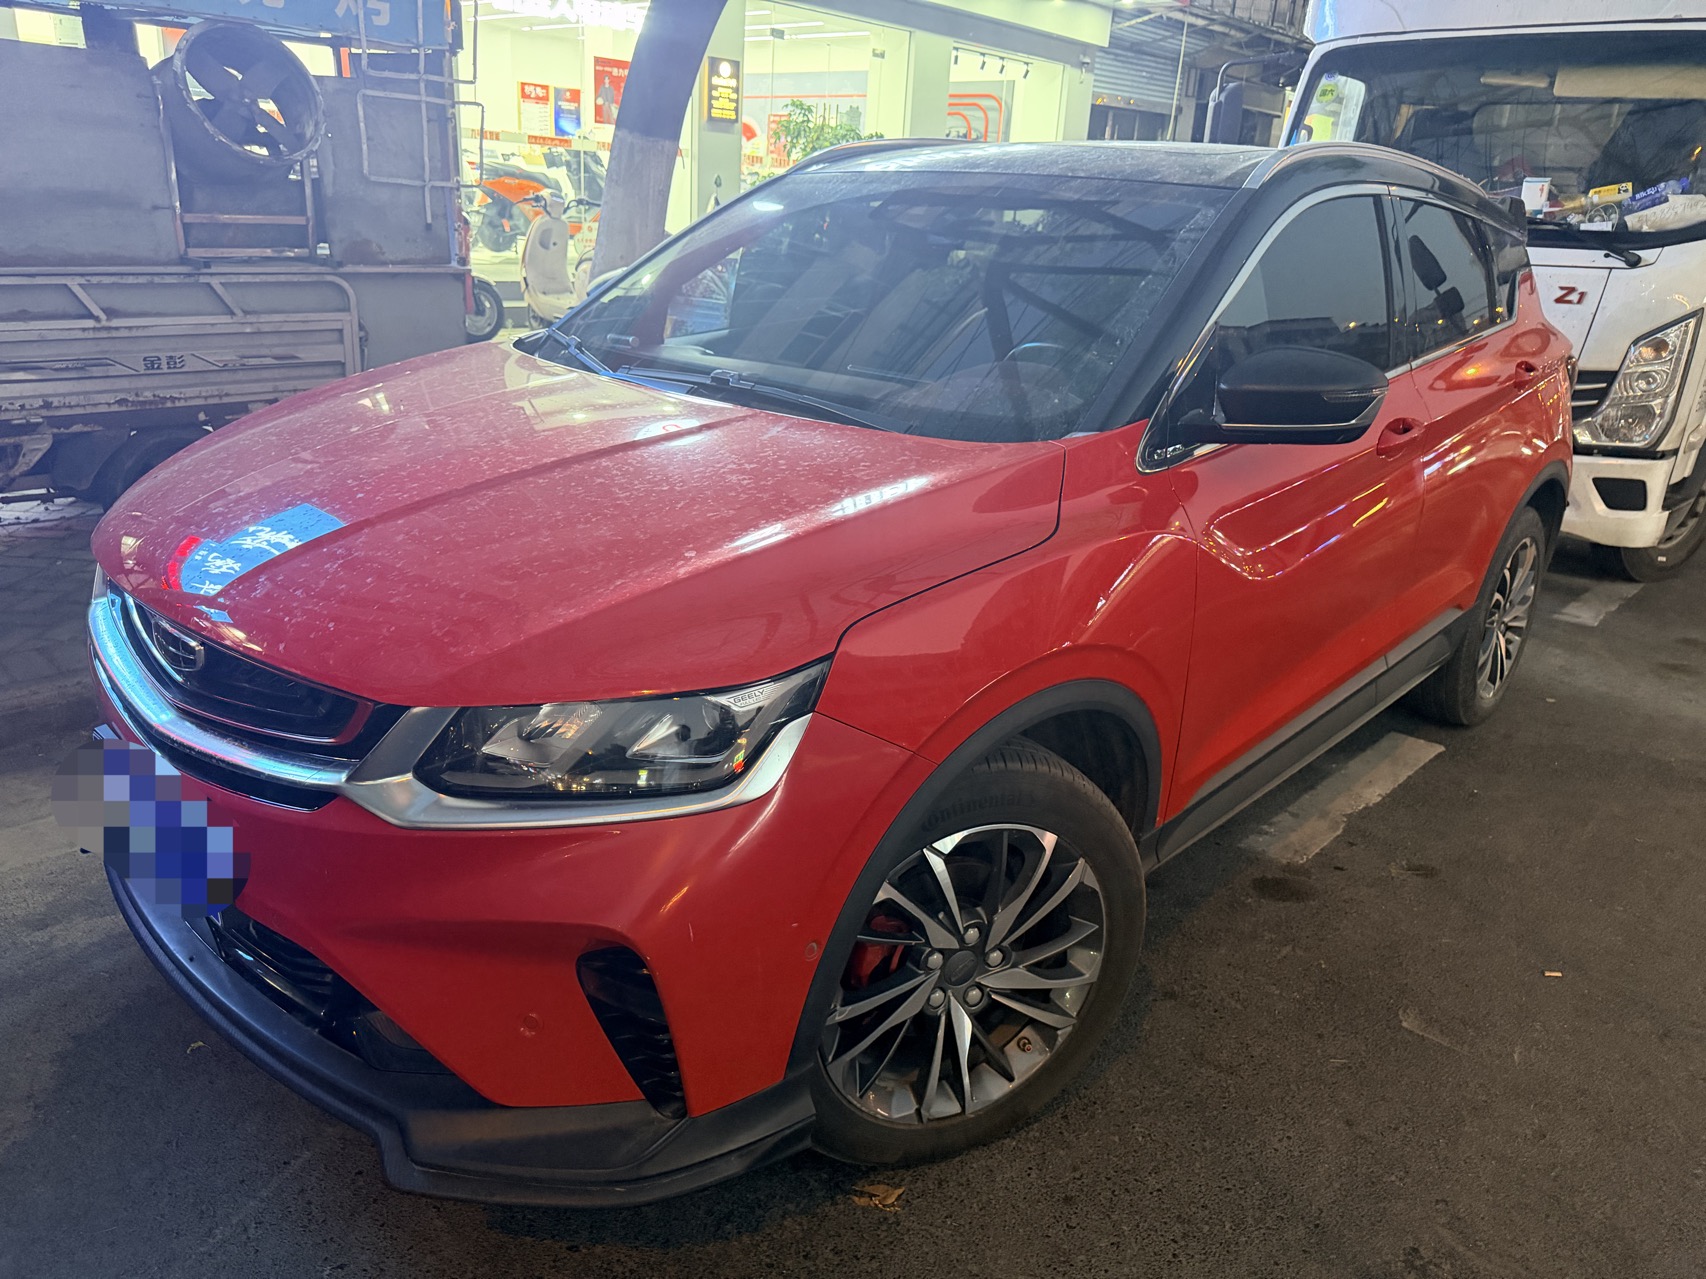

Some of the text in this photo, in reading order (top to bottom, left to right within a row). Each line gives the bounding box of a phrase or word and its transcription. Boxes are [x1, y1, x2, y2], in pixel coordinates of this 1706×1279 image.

[1554, 286, 1587, 304] Z1
[142, 355, 186, 371] 金彭
[733, 689, 765, 704] GEELY
